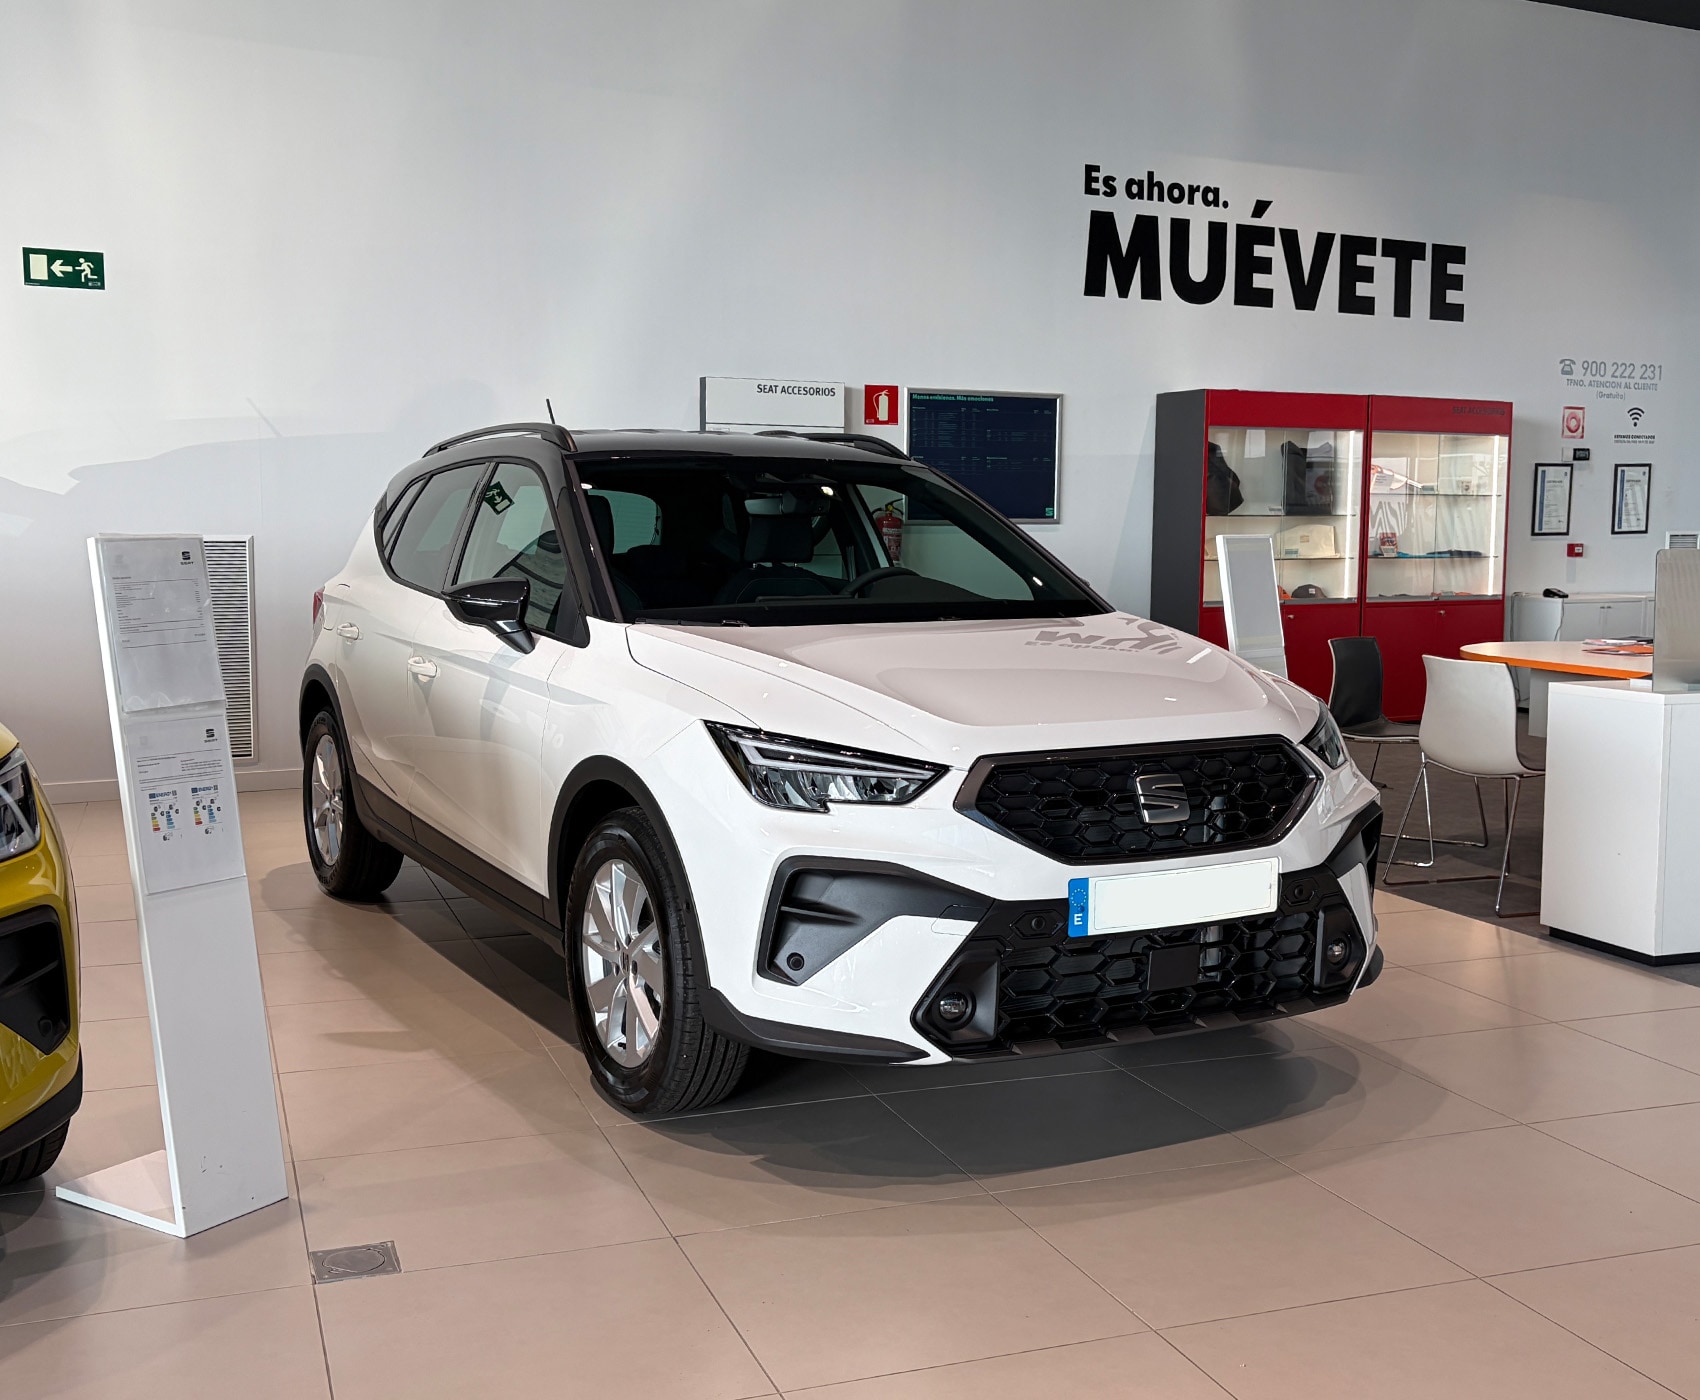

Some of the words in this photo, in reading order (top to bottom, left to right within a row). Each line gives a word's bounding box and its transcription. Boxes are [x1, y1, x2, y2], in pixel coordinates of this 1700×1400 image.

[1084, 164, 1117, 198] Es
[1125, 171, 1229, 209] ahora.
[1083, 199, 1466, 322] MUÉVETE
[1582, 360, 1607, 377] 900
[1611, 362, 1636, 379] 222
[1640, 364, 1662, 380] 231
[756, 383, 779, 394] SEAT
[780, 385, 836, 397] ACCESORIOS
[1633, 383, 1658, 391] CLIENTE
[1073, 913, 1083, 925] E
